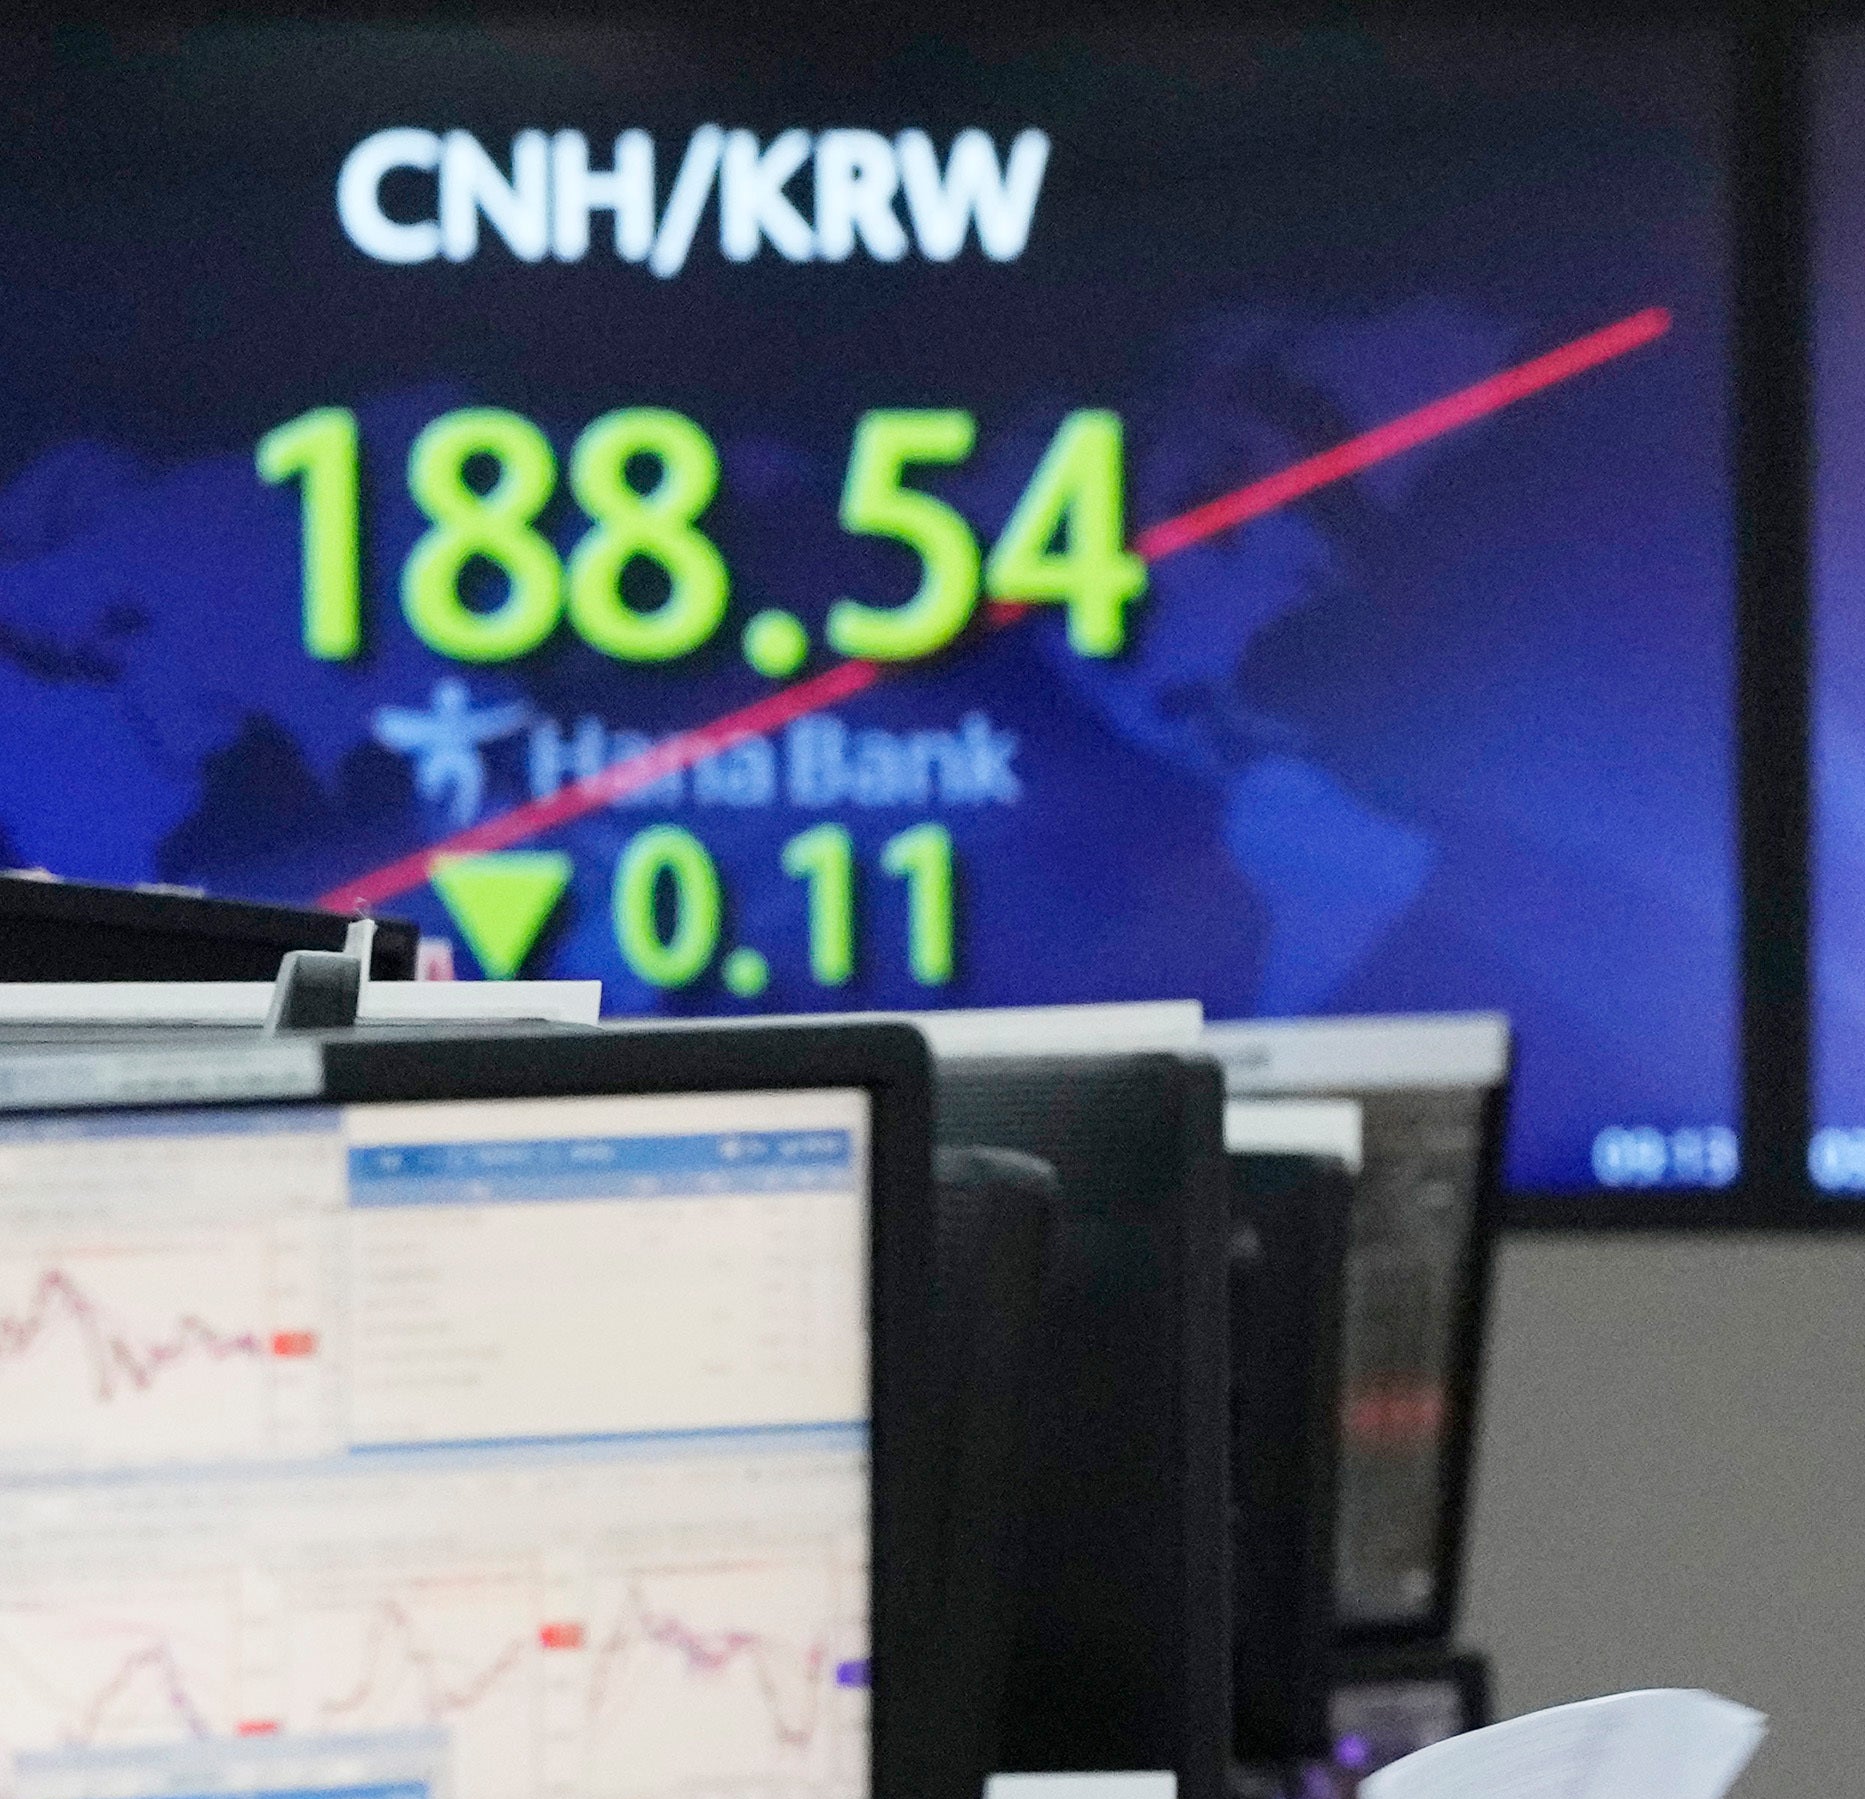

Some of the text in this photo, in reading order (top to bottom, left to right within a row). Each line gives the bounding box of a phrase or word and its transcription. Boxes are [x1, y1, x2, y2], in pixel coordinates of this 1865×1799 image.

[337, 125, 1052, 277] CNH/KRW
[254, 406, 1148, 679] 188.54
[527, 708, 1022, 808] Hana Bank
[610, 822, 958, 998] 0.11
